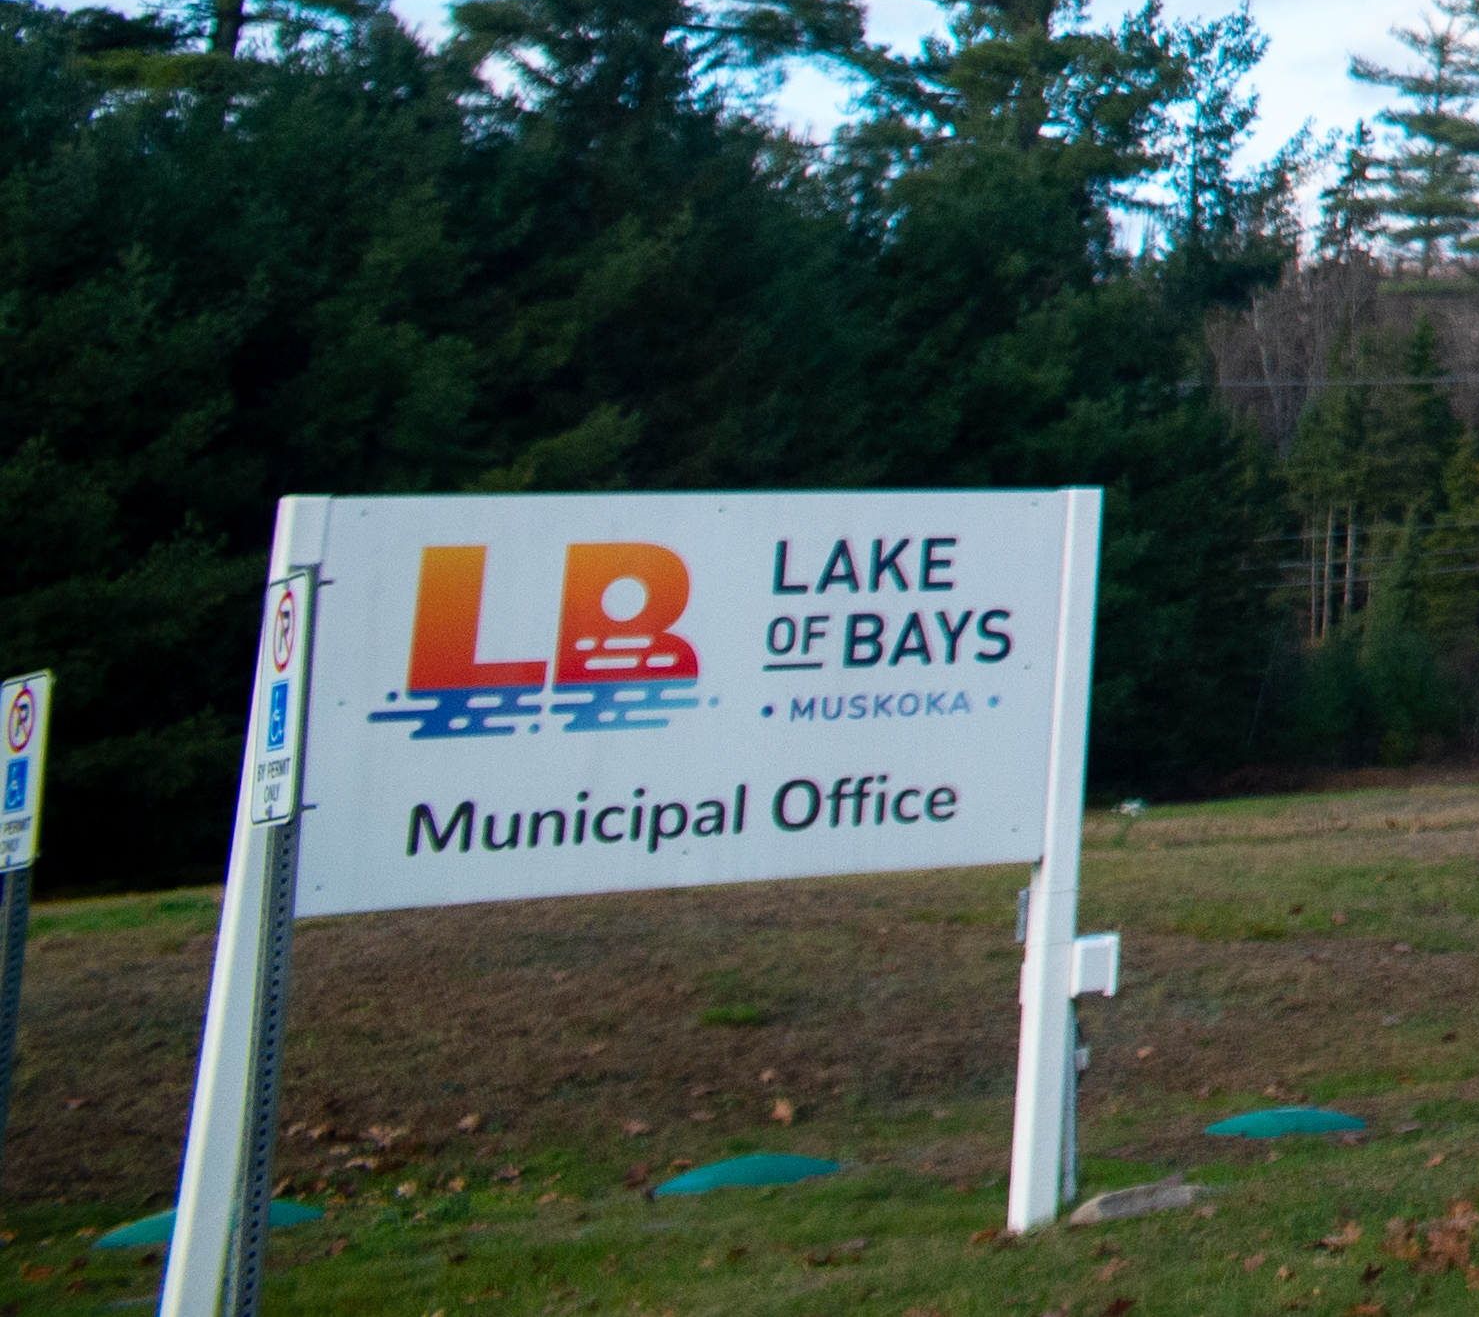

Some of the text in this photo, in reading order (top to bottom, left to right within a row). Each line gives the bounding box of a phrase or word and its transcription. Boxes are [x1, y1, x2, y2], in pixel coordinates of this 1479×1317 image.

[772, 537, 958, 595] LAKE
[405, 541, 698, 692] LB
[764, 608, 1012, 668] OF BAYS
[789, 691, 972, 722] MUSKOKA
[257, 757, 291, 782] BY PERMIT
[263, 782, 281, 804] ONLY
[404, 773, 958, 856] Municipal Office
